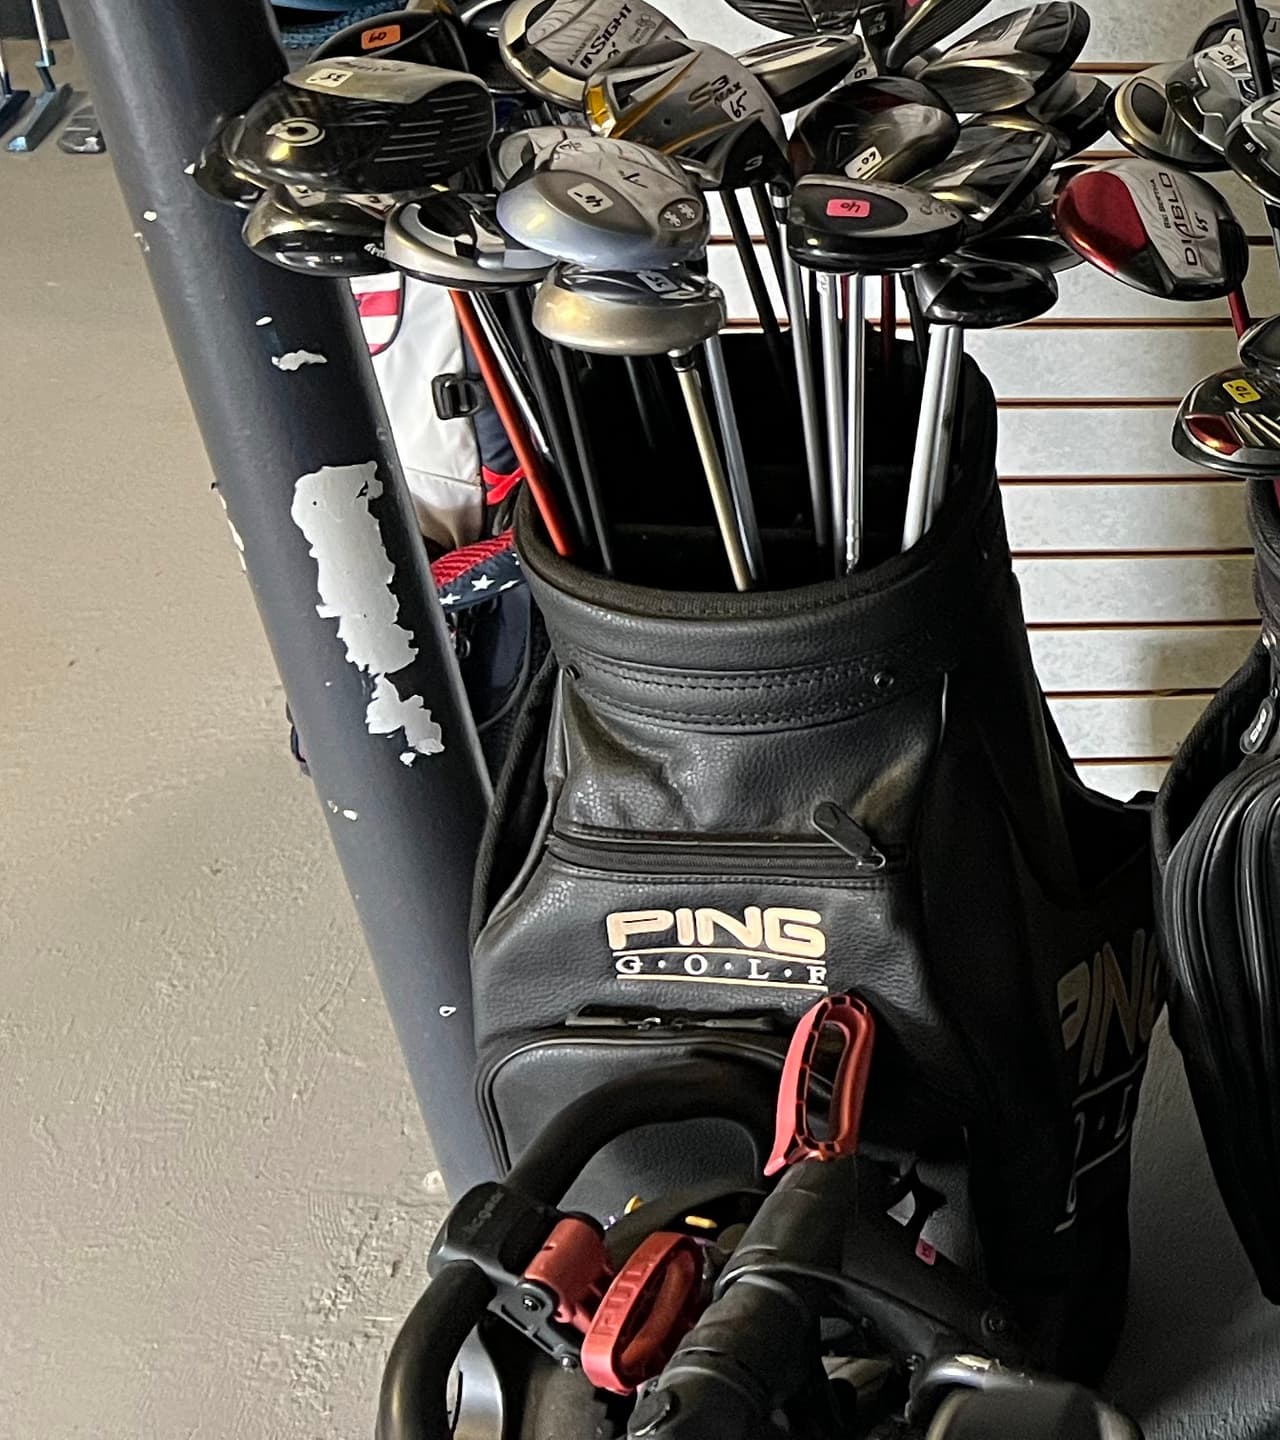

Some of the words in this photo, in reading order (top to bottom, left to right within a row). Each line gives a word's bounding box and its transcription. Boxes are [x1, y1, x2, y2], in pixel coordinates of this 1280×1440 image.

[579, 3, 634, 70] INSIGHT
[1158, 172, 1206, 266] DIABLO
[605, 905, 827, 959] PING
